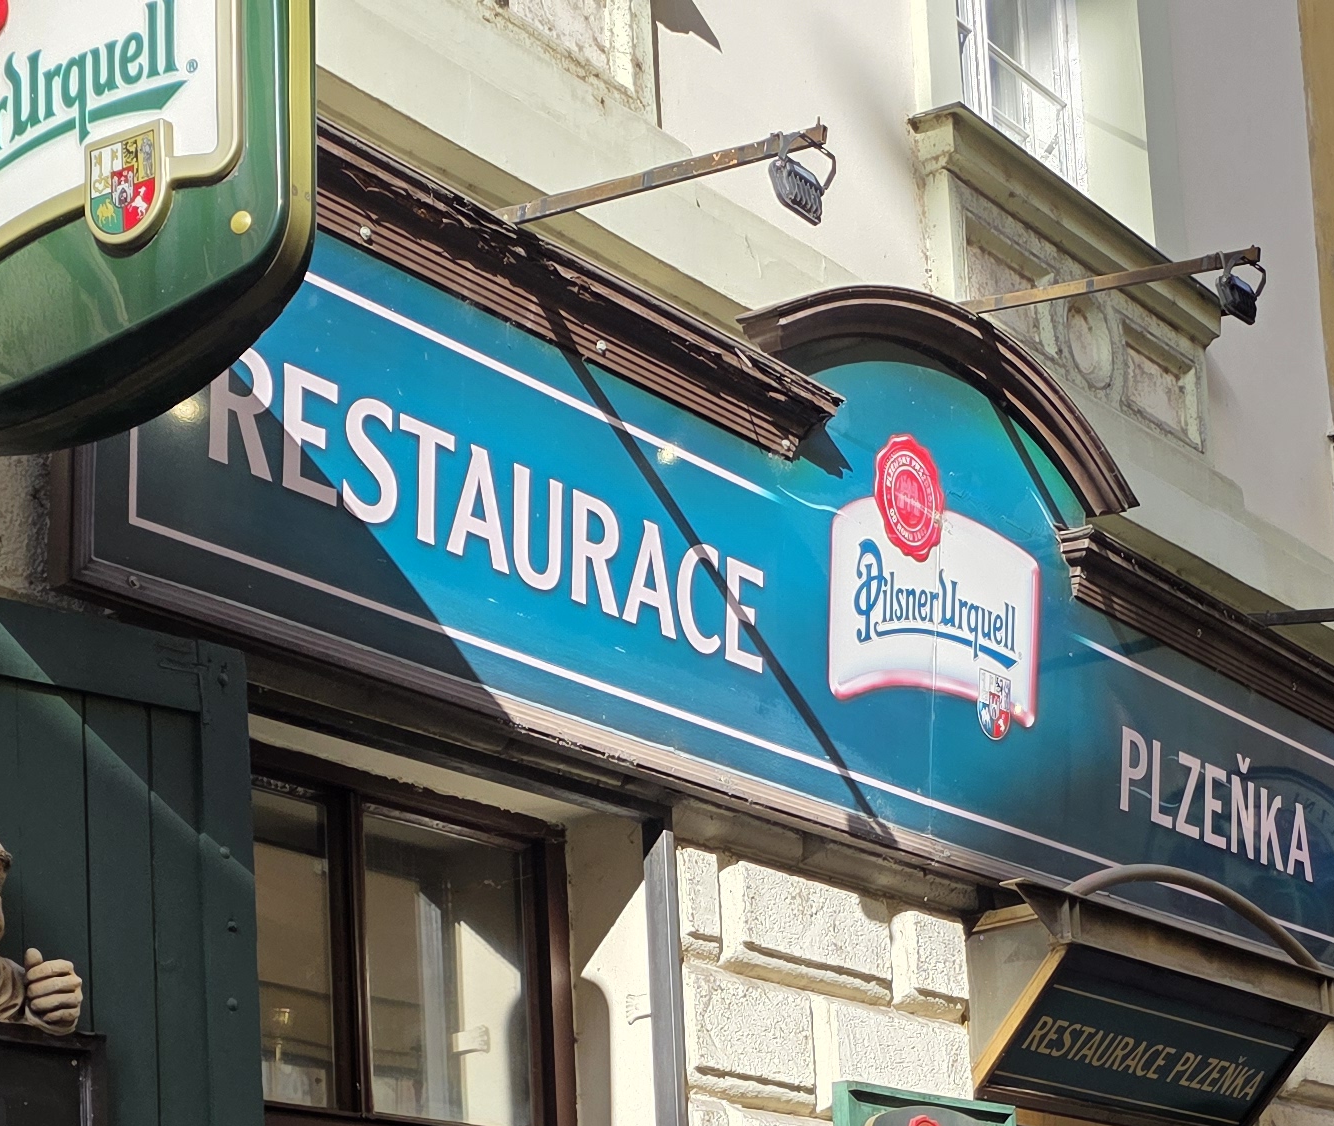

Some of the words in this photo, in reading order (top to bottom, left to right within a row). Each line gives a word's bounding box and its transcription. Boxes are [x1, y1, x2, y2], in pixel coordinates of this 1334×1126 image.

[4, 0, 178, 146] Urquell
[208, 347, 764, 674] RESTAURACE
[854, 538, 939, 644] Pilsner
[938, 568, 1017, 661] Urquell
[1119, 725, 1314, 883] PLZEŇKA
[1021, 1014, 1176, 1080] RESTAURACE
[1166, 1050, 1264, 1101] PLZEŇKA
